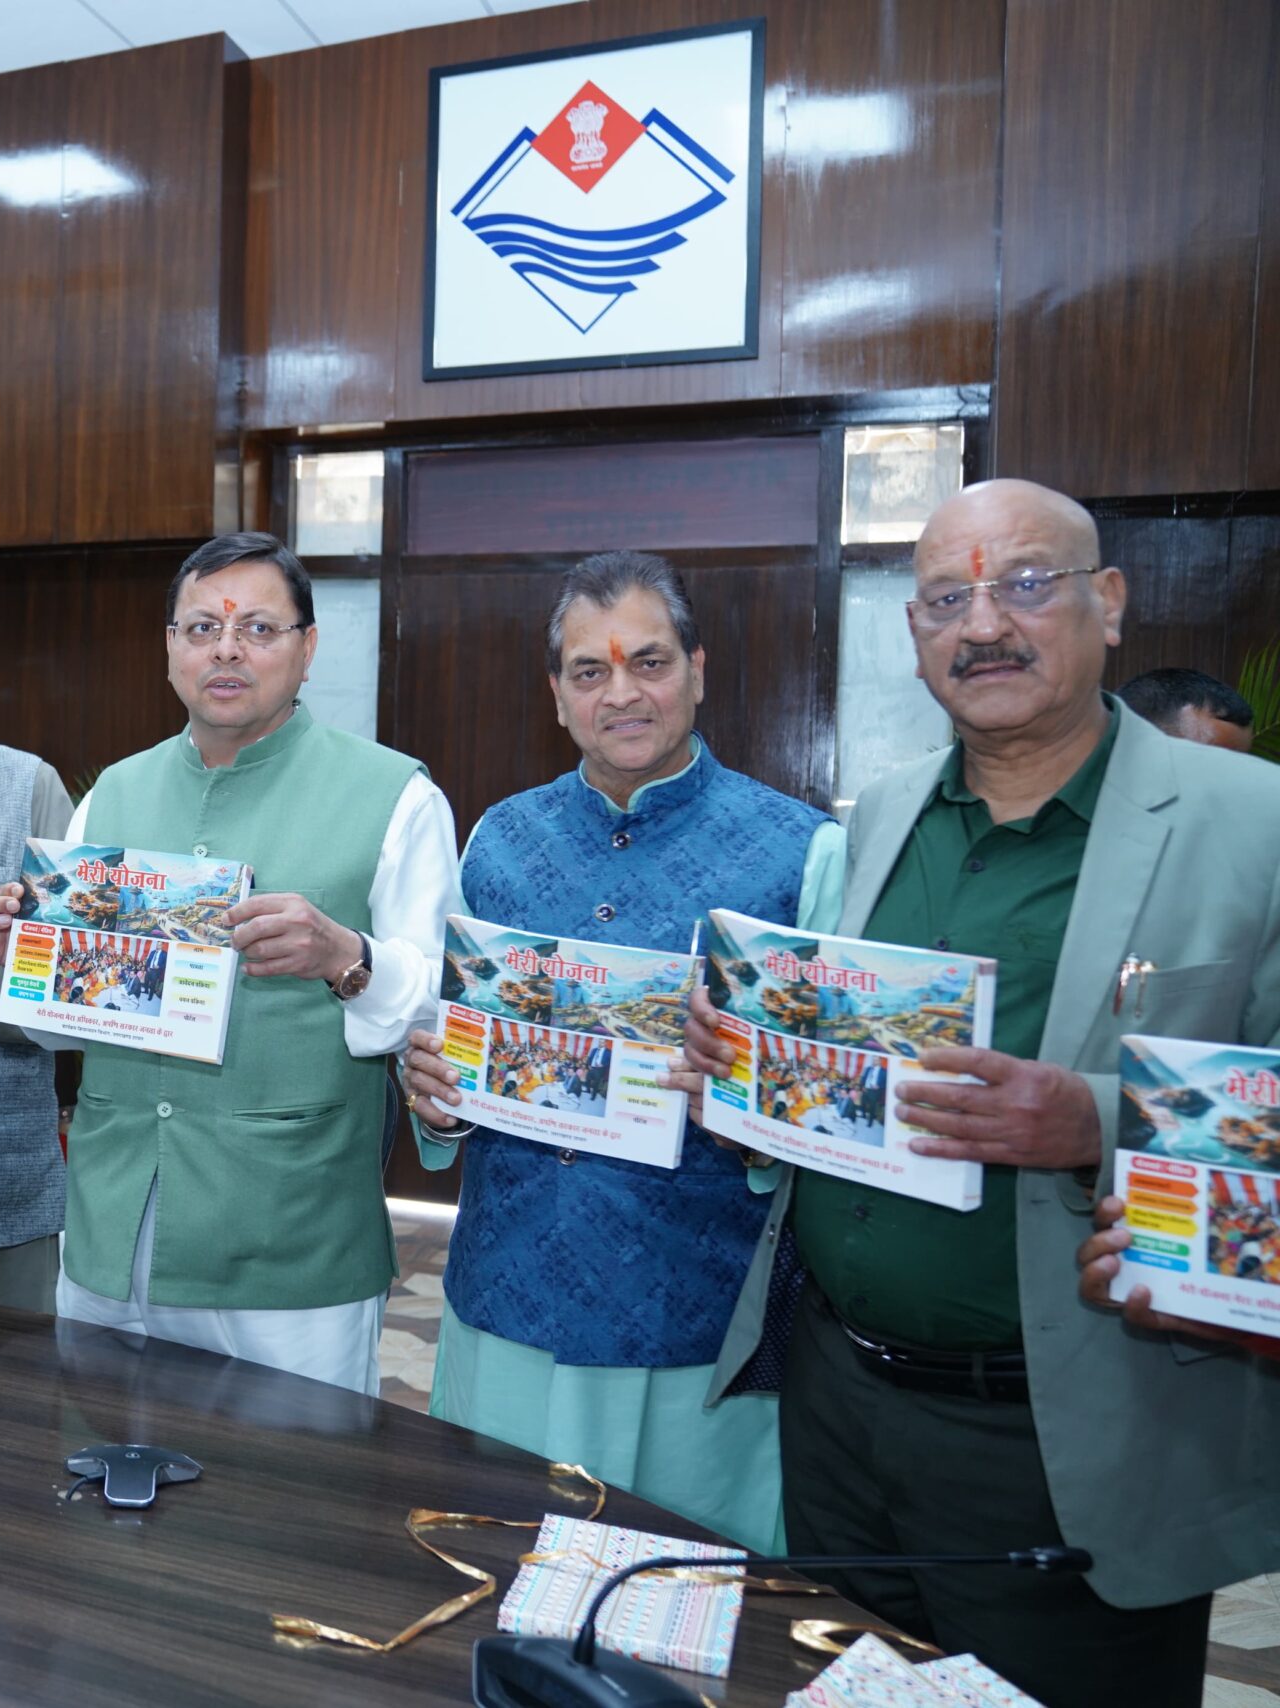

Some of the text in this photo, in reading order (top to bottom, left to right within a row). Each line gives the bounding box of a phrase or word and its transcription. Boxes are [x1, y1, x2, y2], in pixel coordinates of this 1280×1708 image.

[77, 859, 168, 890] मेरी योजना
[506, 946, 609, 984] मेरी योजना
[765, 950, 878, 993] मेरी योजना
[1226, 1067, 1278, 1105] मेरी
